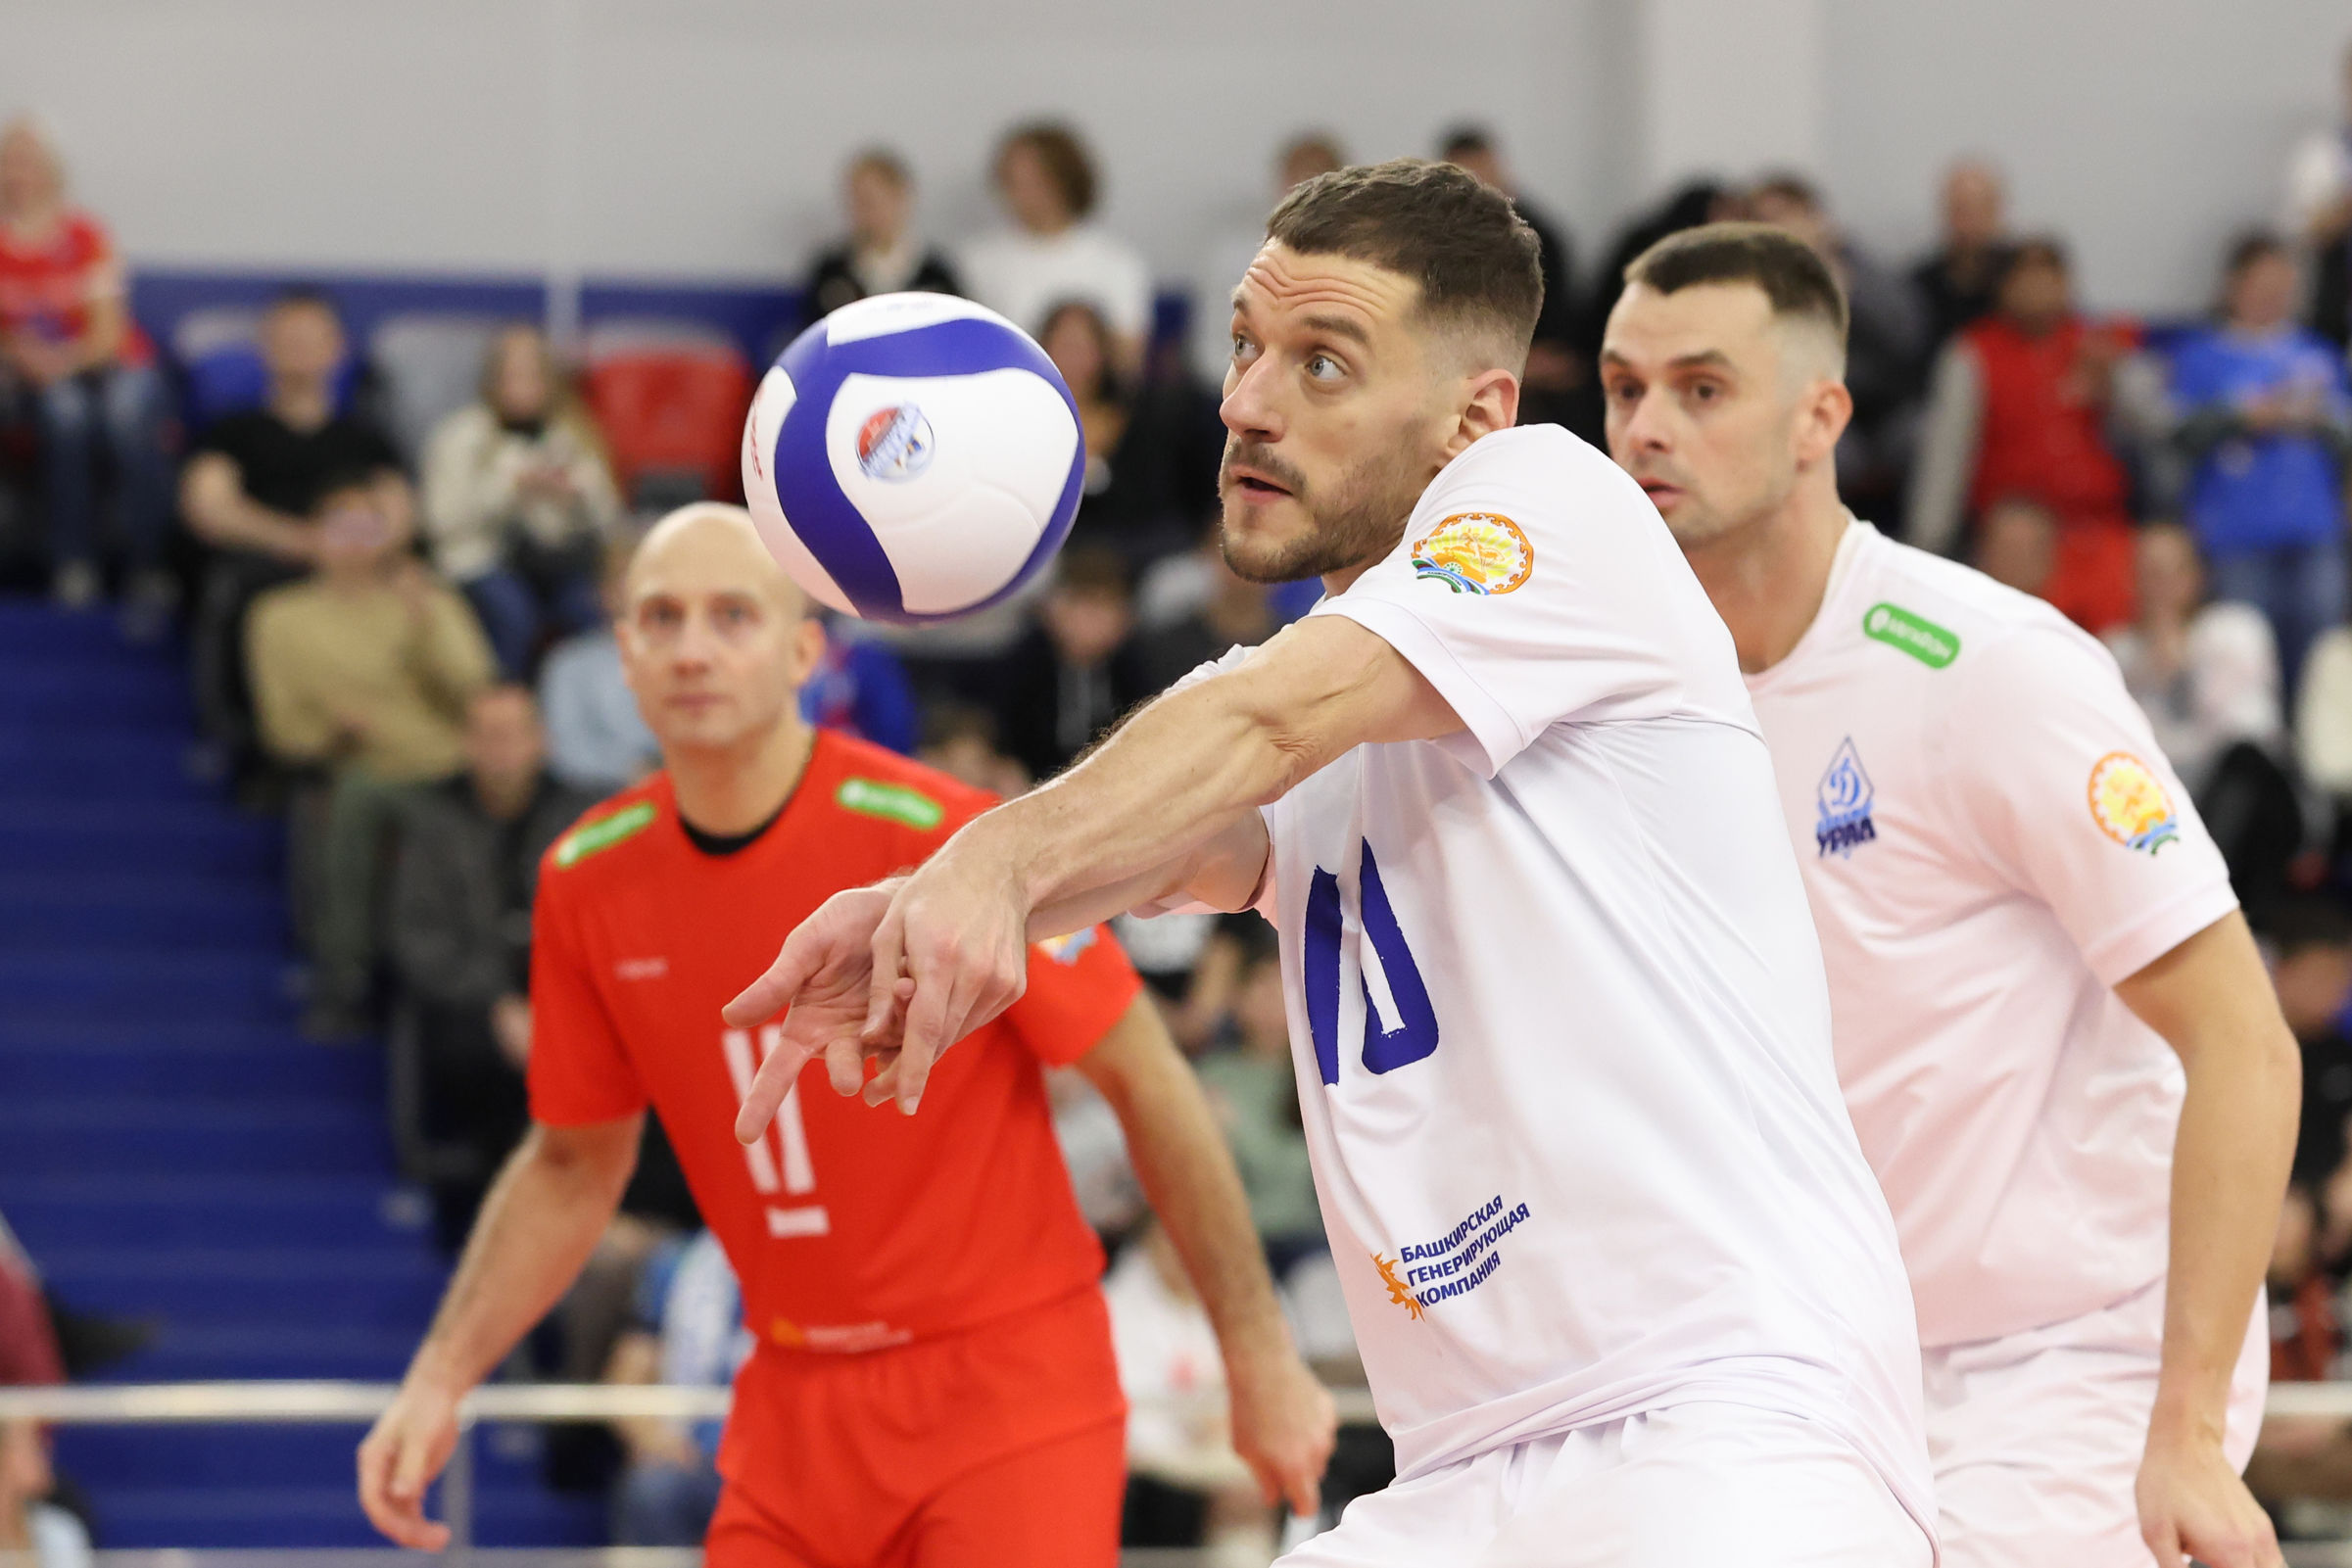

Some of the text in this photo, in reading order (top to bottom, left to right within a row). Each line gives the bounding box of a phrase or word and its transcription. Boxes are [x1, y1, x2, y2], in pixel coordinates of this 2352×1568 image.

[1817, 815, 1876, 858] УРАЛ
[1304, 835, 1439, 1087] 10
[722, 1022, 817, 1197] 11
[1400, 1195, 1504, 1263] БАШКИРСКАЯ
[1407, 1203, 1530, 1287] ГЕНЕРИРУЮЩАЯ
[1416, 1251, 1502, 1308] КОМПАНИЯ
